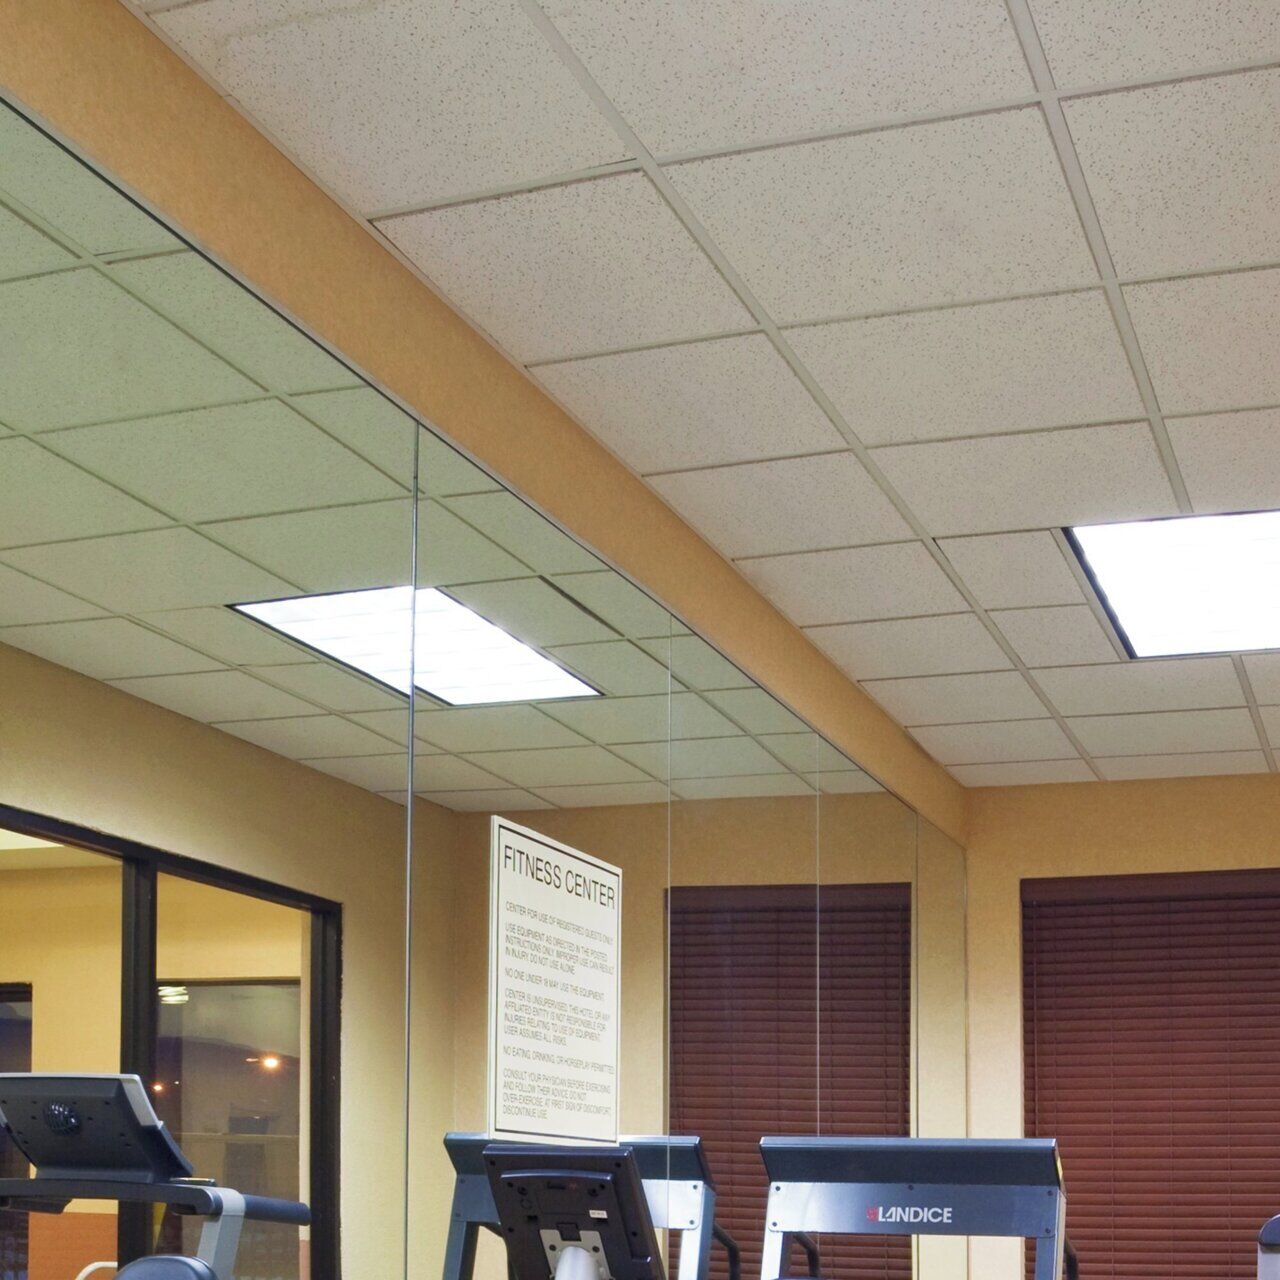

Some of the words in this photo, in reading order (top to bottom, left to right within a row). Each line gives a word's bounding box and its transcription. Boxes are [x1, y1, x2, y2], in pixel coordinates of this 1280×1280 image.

[504, 845, 561, 889] FITNESS
[565, 870, 615, 910] CENTER
[506, 901, 526, 917] CENTER
[557, 919, 583, 936] REGISTERED
[585, 929, 602, 943] GUESTS
[517, 925, 544, 943] EQUIPMENT
[553, 937, 575, 952] DIRECTED
[591, 949, 607, 963] POSTED
[505, 934, 541, 953] INSTRUCTIONS
[556, 950, 578, 964] IMPROPER
[599, 963, 614, 975] RESULT
[526, 973, 542, 985] UNDER
[505, 988, 525, 1002] CENTER
[569, 1004, 579, 1015] THIS
[580, 1007, 593, 1018] HOTEL
[504, 1000, 532, 1015] AFFILIATED
[533, 1007, 549, 1019] ENTITY
[567, 1015, 596, 1030] RESPONSIBLE
[504, 1012, 526, 1026] INJURIES
[527, 1018, 550, 1031] RELATING
[504, 1025, 517, 1036] USER
[519, 1028, 542, 1041] ASSUMES
[565, 1057, 589, 1070] HORSEPLAY
[503, 1068, 527, 1081] CONSULT
[528, 1073, 541, 1083] YOUR
[542, 1075, 566, 1087] PHYSICIAN
[567, 1079, 585, 1089] BEFORE
[586, 1082, 611, 1093] EXERCISING
[515, 1083, 536, 1094] FOLLOW
[503, 1105, 536, 1117] DISCONTINUE
[552, 1100, 564, 1109] FIRST
[565, 1102, 575, 1111] SIGN
[878, 1205, 953, 1224] LANDICE
